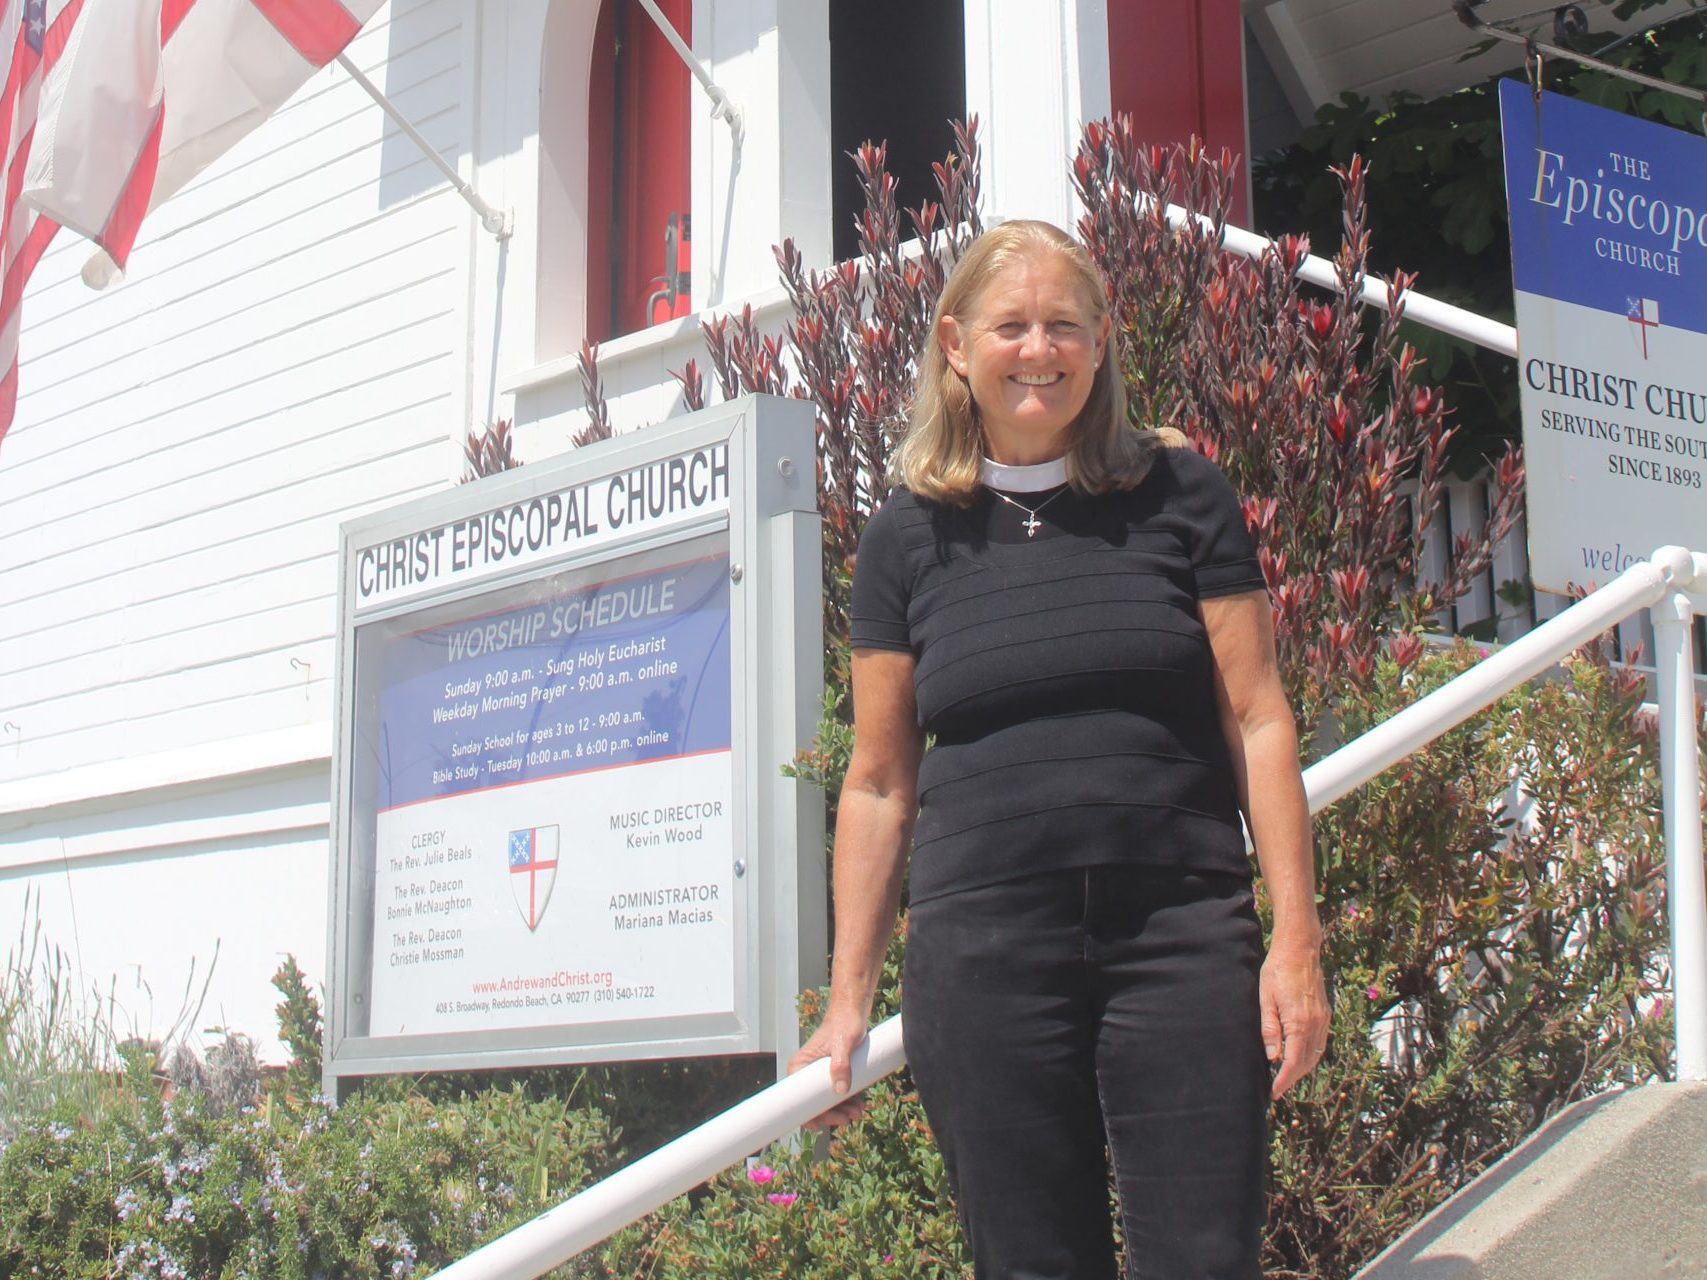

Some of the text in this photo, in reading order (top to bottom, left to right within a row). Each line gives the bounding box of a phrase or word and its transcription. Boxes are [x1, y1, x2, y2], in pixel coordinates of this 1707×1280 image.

[1609, 152, 1651, 181] THE
[1595, 237, 1681, 276] CHURCH
[1526, 358, 1638, 410] CHRIST
[1541, 409, 1621, 443] SERVING
[1624, 426, 1661, 450] THE
[1608, 454, 1702, 489] SINCE 1893
[359, 444, 730, 597] CHRIST EPISCOPAL CHURCH
[448, 578, 676, 663] WORSHIP SCHEDULE
[444, 677, 482, 699] Sunday
[485, 669, 509, 689] 9:00
[511, 668, 535, 684] a.m.
[546, 658, 575, 676] Sung
[578, 647, 605, 669] Holy
[608, 636, 666, 662] Eucharist
[433, 702, 478, 724] Weekday
[481, 691, 527, 713] Morning
[531, 683, 567, 704] Prayer
[578, 671, 604, 692] 9:00
[607, 670, 633, 686] a.m.
[638, 658, 678, 680] online
[451, 738, 482, 757] Sunday
[484, 731, 514, 751] School
[516, 728, 530, 744] for
[532, 727, 553, 744] ages
[556, 722, 562, 737] 3
[564, 722, 575, 735] to
[578, 717, 590, 733] 12
[598, 711, 621, 727] 9:00
[623, 709, 645, 722] a.m.
[432, 767, 452, 784] Bible
[455, 762, 479, 780] Study
[487, 755, 522, 773] Tuesday
[526, 749, 551, 767] 10:00
[553, 748, 573, 761] a.m.
[575, 742, 584, 758] &
[586, 738, 608, 756] 6:00
[610, 737, 633, 756] p.m.
[636, 729, 669, 747] online
[610, 801, 722, 830] MUSIC DIRECTOR
[411, 830, 446, 849] CLERGY
[626, 823, 702, 848] Kevin Wood
[390, 844, 473, 873] The Rev. Julie Beals
[394, 878, 463, 900] The Rev. Deacon
[609, 884, 719, 910] ADMINISTRATOR
[387, 895, 472, 920] Bonnie McNaughton
[614, 907, 713, 931] Mariana Macias
[392, 928, 462, 948] The Rev. Deacon
[390, 947, 464, 967] Christie Mossman
[472, 970, 613, 994] www.AndrewandChrist.org
[449, 1001, 455, 1014] S.
[456, 999, 490, 1014] Broadway,
[492, 997, 524, 1010] Redondo
[525, 994, 549, 1008] Beach,
[551, 993, 562, 1006] CA
[566, 990, 590, 1004] 90277
[593, 988, 614, 1004] (310)
[616, 985, 655, 1001] 540-1722
